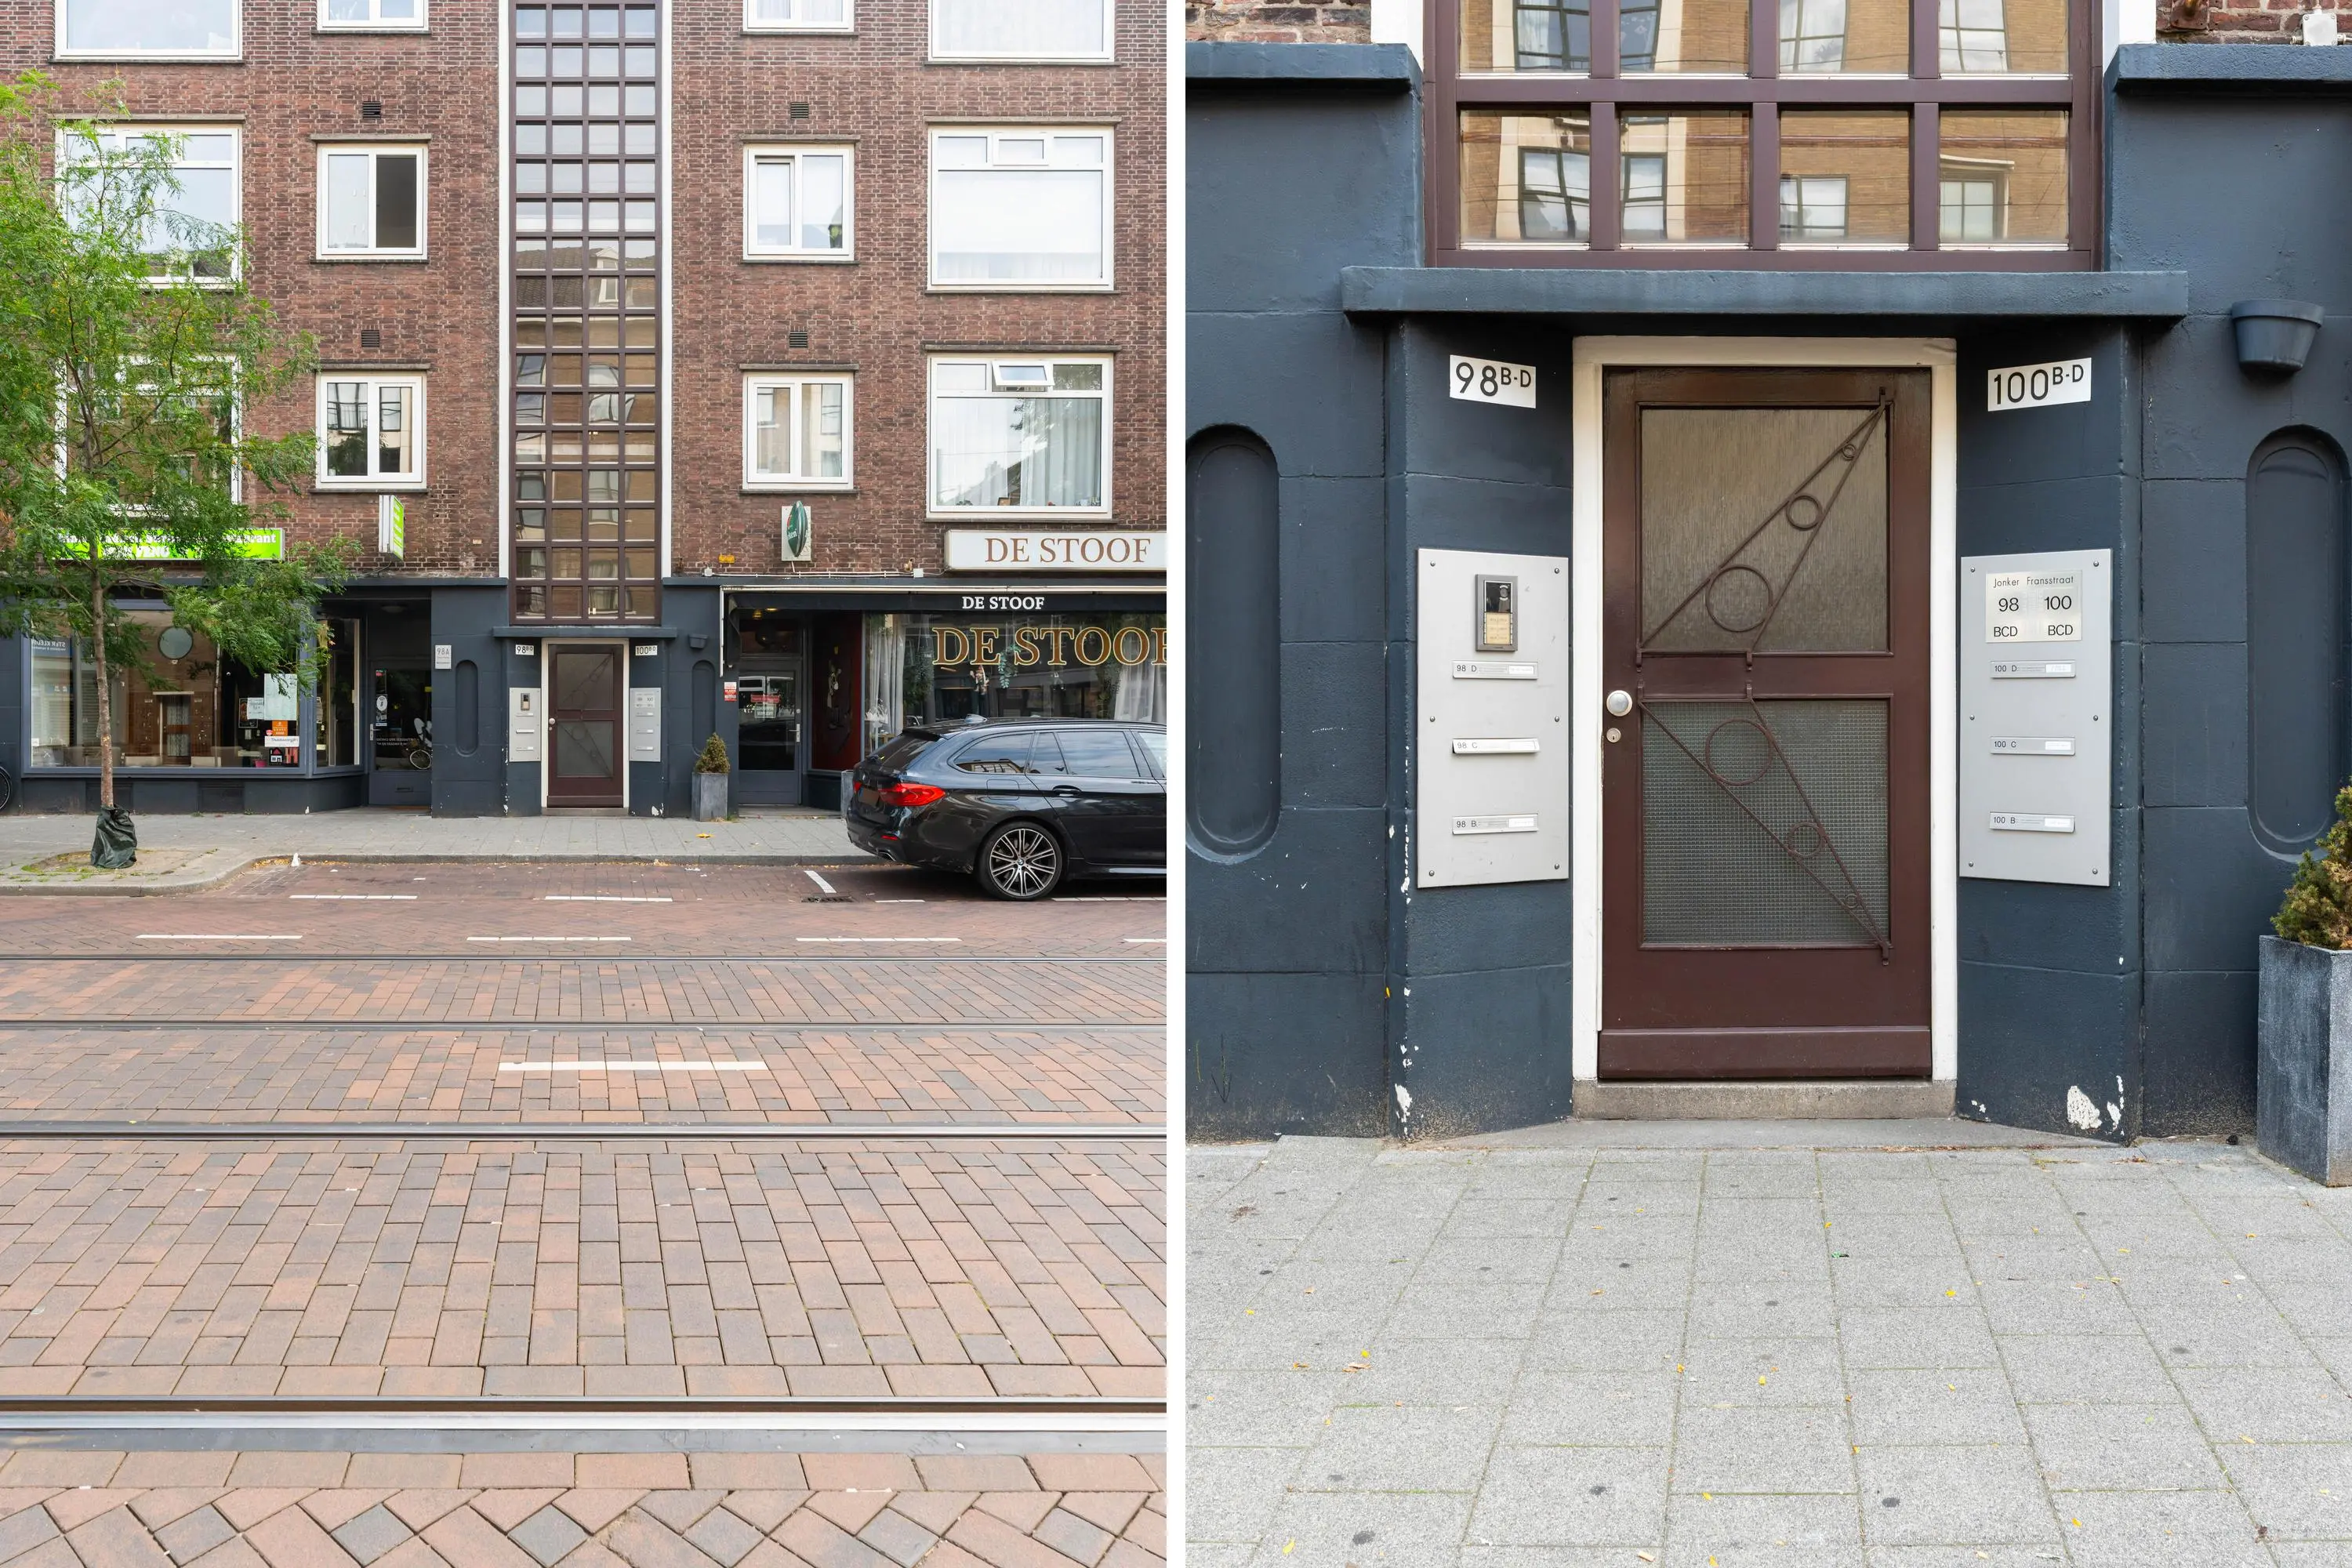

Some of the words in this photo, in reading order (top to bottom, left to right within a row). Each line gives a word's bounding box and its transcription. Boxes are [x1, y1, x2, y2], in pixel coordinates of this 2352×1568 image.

[985, 537, 1029, 562] DE
[1040, 537, 1151, 563] STOOF
[1994, 577, 2020, 588] Jonker
[2027, 575, 2074, 585] Fransstraat
[962, 596, 985, 609] DE
[989, 596, 1045, 609] STOOF
[1998, 597, 2020, 612] 98
[2044, 595, 2072, 610] 100
[1994, 626, 2018, 637] BCD
[2048, 624, 2074, 636] BCD
[932, 627, 1000, 665] DE
